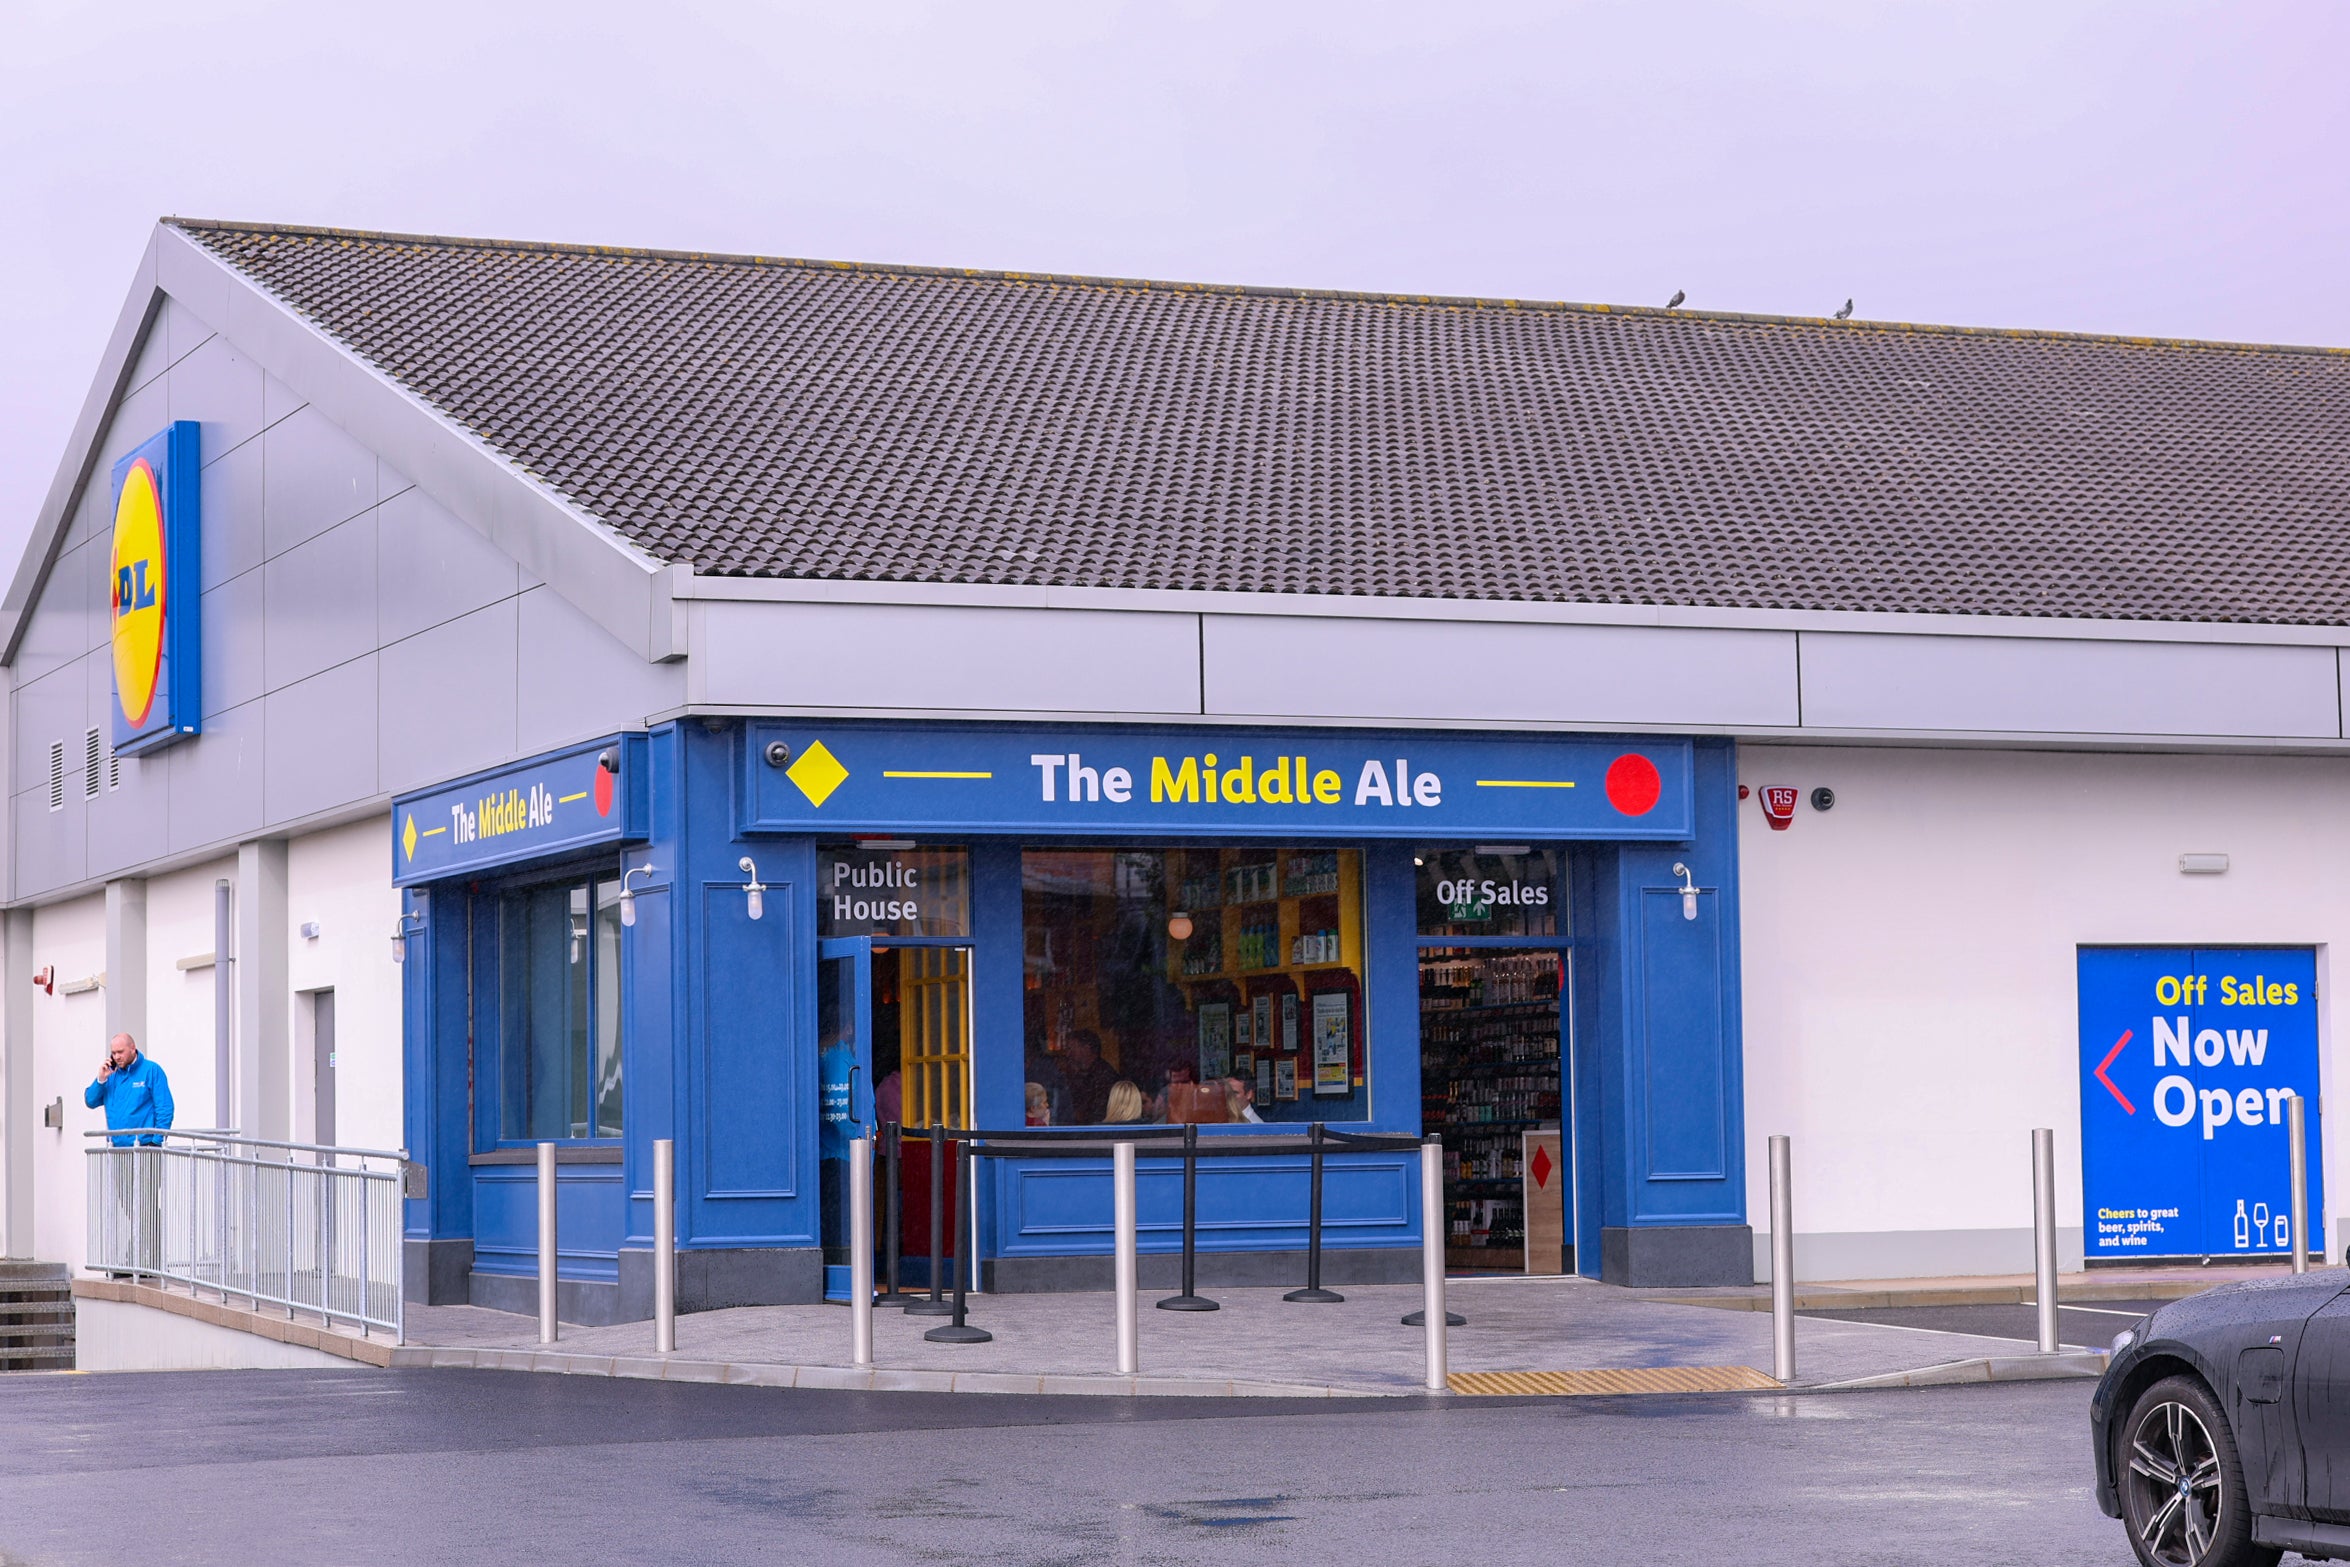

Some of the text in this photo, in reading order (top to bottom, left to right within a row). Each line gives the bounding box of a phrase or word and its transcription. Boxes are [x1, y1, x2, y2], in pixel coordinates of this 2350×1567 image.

[1031, 753, 1441, 806] The Middle Ale
[1773, 790, 1792, 804] RS
[452, 783, 552, 844] The Middle Ale
[833, 861, 917, 888] Public
[1437, 879, 1549, 905] Off Sales
[834, 895, 918, 921] House
[2155, 975, 2299, 1006] Off Sales
[2152, 1016, 2269, 1067] Now
[2153, 1074, 2297, 1141] Open
[2098, 1207, 2179, 1221] Cheers to great
[2098, 1220, 2165, 1235] beer, spirits,
[2098, 1234, 2148, 1247] and wine
